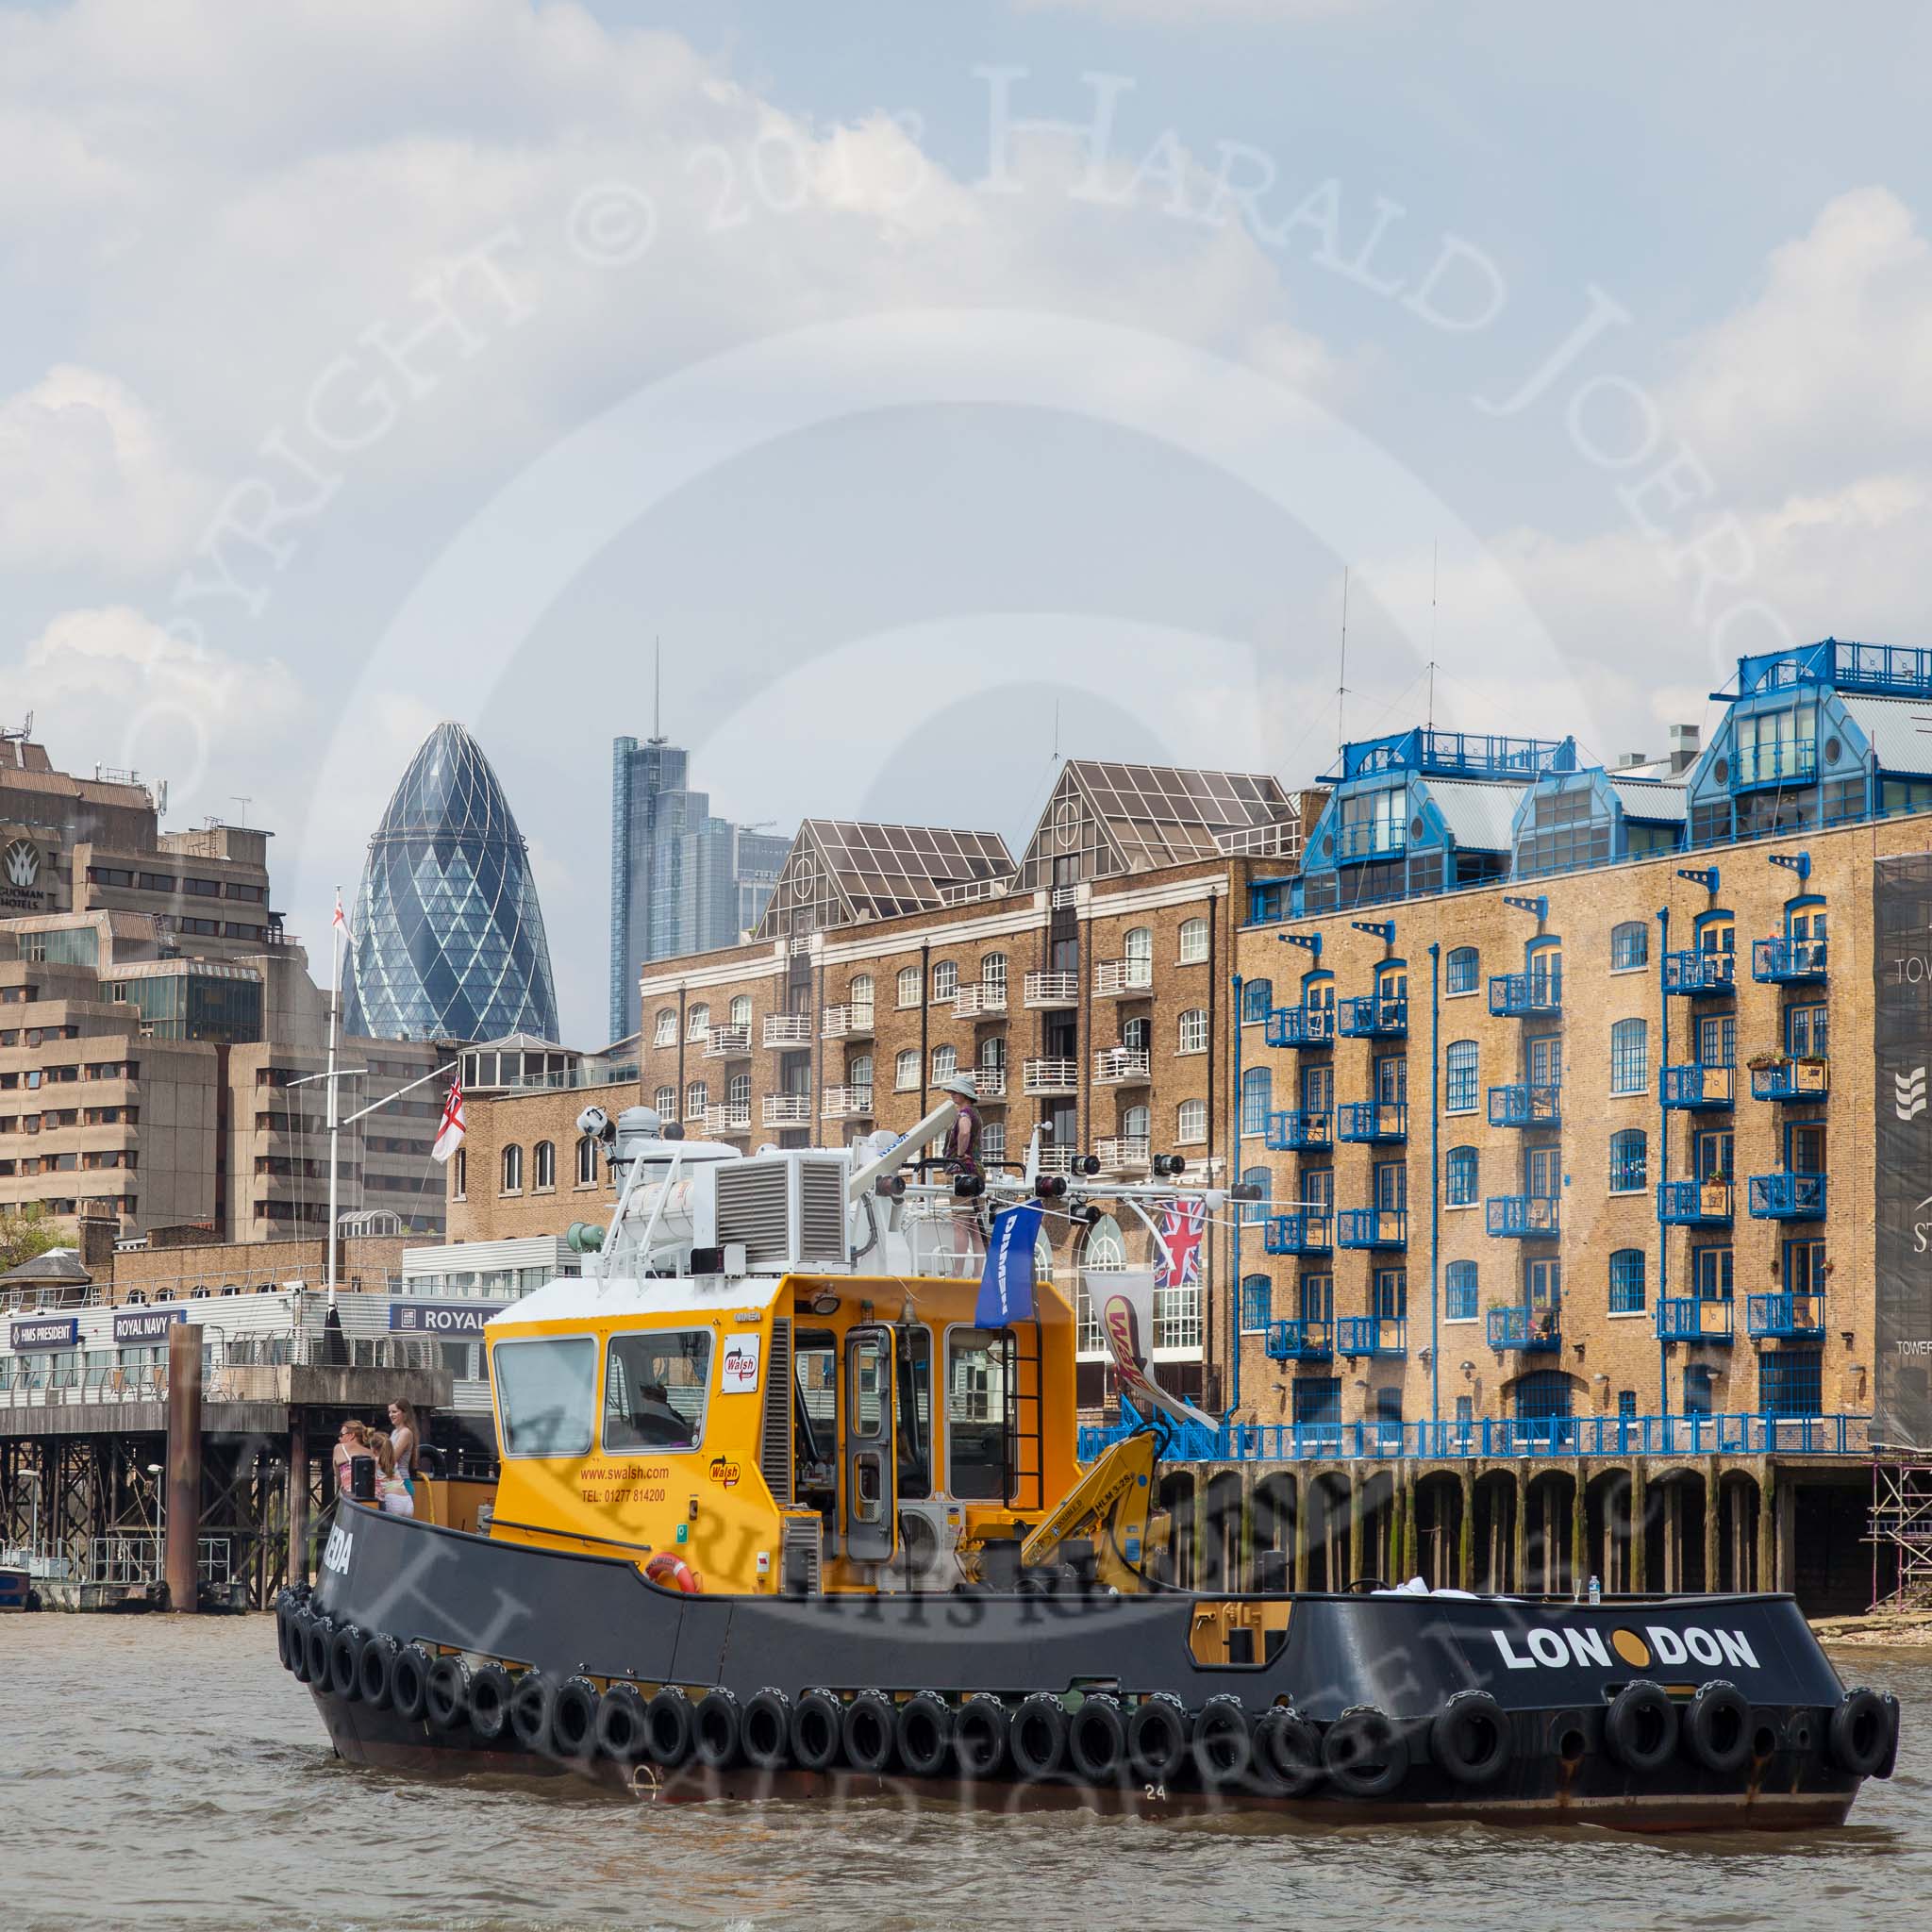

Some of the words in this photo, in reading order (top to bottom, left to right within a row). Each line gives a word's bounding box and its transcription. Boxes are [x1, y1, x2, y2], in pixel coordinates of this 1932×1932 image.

[117, 1320, 142, 1337] ROYAL
[144, 1317, 168, 1335] NAVY
[425, 1310, 484, 1330] ROYAL
[21, 1328, 36, 1341] HMS
[37, 1324, 71, 1341] PRESIDENT
[727, 1358, 754, 1371] Walsh
[581, 1465, 669, 1480] www.swalsh.com
[712, 1465, 738, 1478] Walsh
[582, 1490, 602, 1503] TEL:
[604, 1489, 631, 1503] 01277
[633, 1489, 665, 1502] 814200
[1095, 1491, 1113, 1511] HLM
[324, 1521, 354, 1575] EDA
[1144, 1784, 1165, 1800] 24
